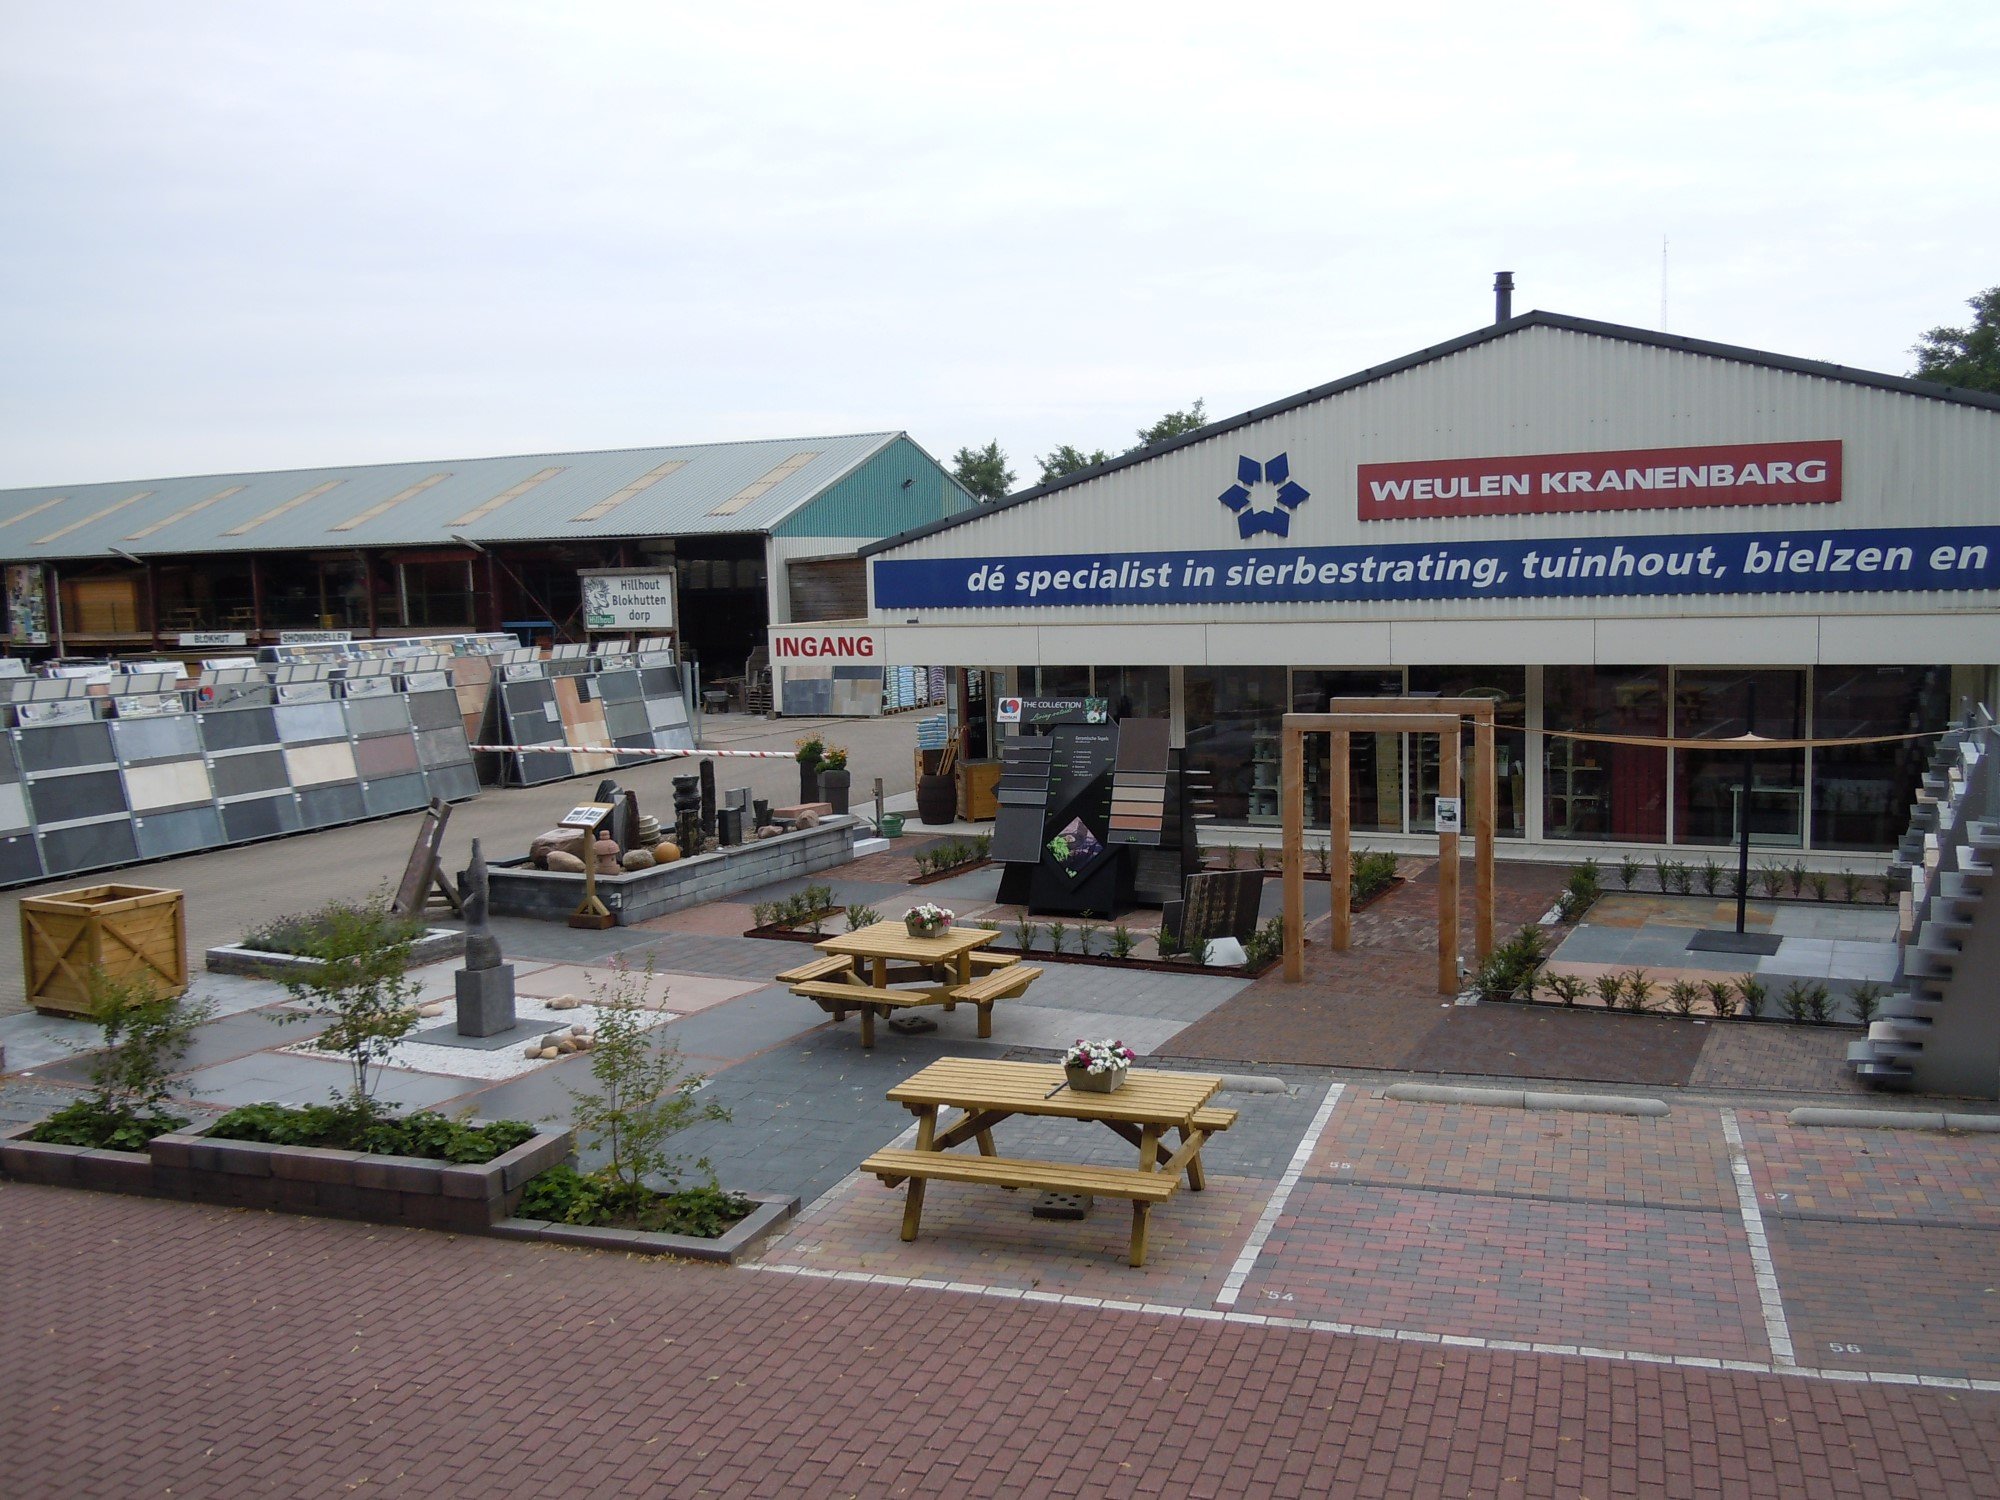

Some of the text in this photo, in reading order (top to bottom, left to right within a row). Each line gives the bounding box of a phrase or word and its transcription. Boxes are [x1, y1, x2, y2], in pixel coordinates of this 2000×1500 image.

[1369, 460, 1827, 501] WEULEN KRANENBARG
[967, 540, 1988, 597] dé specialist in sierbestrating, tuinhout, bielzen en
[621, 579, 660, 591] Hillhout
[612, 595, 667, 606] Blokhutten
[629, 609, 651, 623] dorp
[194, 634, 230, 643] BLOKHUT
[282, 632, 348, 643] SHOWMODELLEN
[775, 636, 874, 657] INGANG
[1023, 701, 1082, 709] THE COLLECTION
[1329, 1161, 1351, 1169] 55
[1764, 1192, 1789, 1200] 57
[1267, 1290, 1294, 1301] 54
[1829, 1342, 1861, 1354] 56
